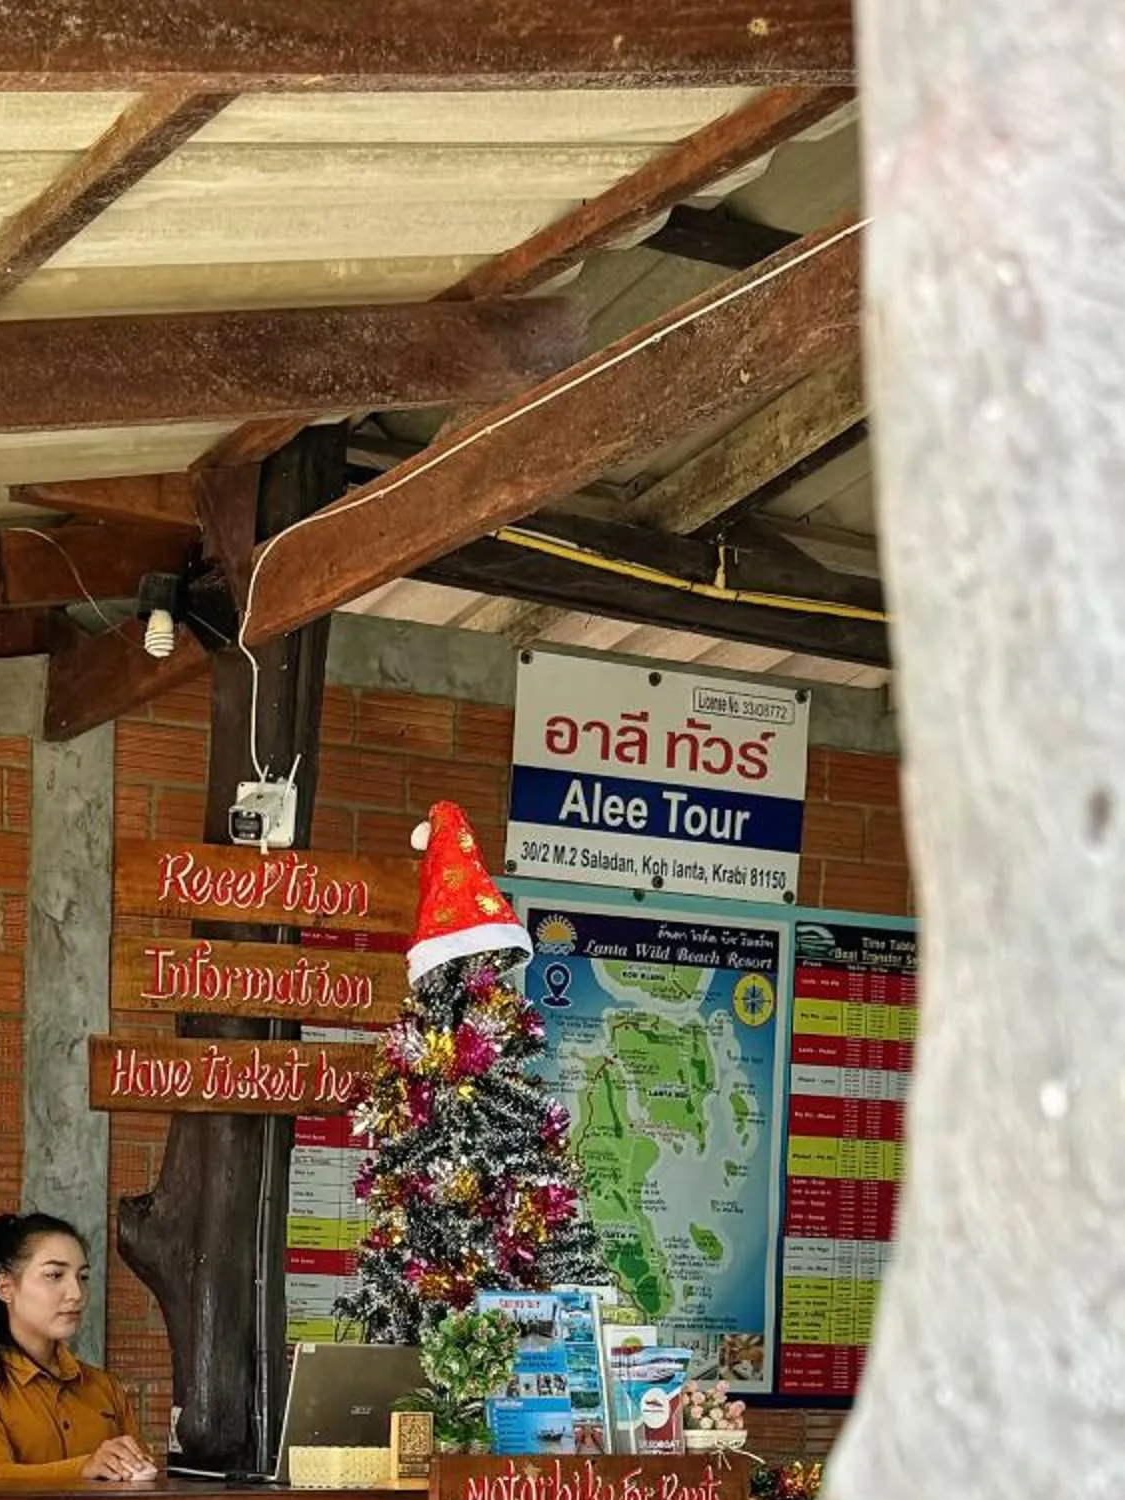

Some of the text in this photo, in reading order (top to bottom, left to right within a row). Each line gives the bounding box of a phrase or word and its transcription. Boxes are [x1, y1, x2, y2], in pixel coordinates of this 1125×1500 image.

[545, 711, 776, 781] อาลี ทัวร์
[559, 779, 750, 841] Alee Tour
[520, 841, 549, 863] 30/2
[580, 848, 638, 876] Saladan,
[642, 856, 668, 877] Koh
[713, 864, 747, 887] Krabi
[750, 869, 787, 891] 81150
[141, 939, 373, 1009] Information
[583, 939, 773, 970] Lanta Wild Beach Resort
[112, 1048, 193, 1098] Have
[201, 1045, 311, 1102] ticket
